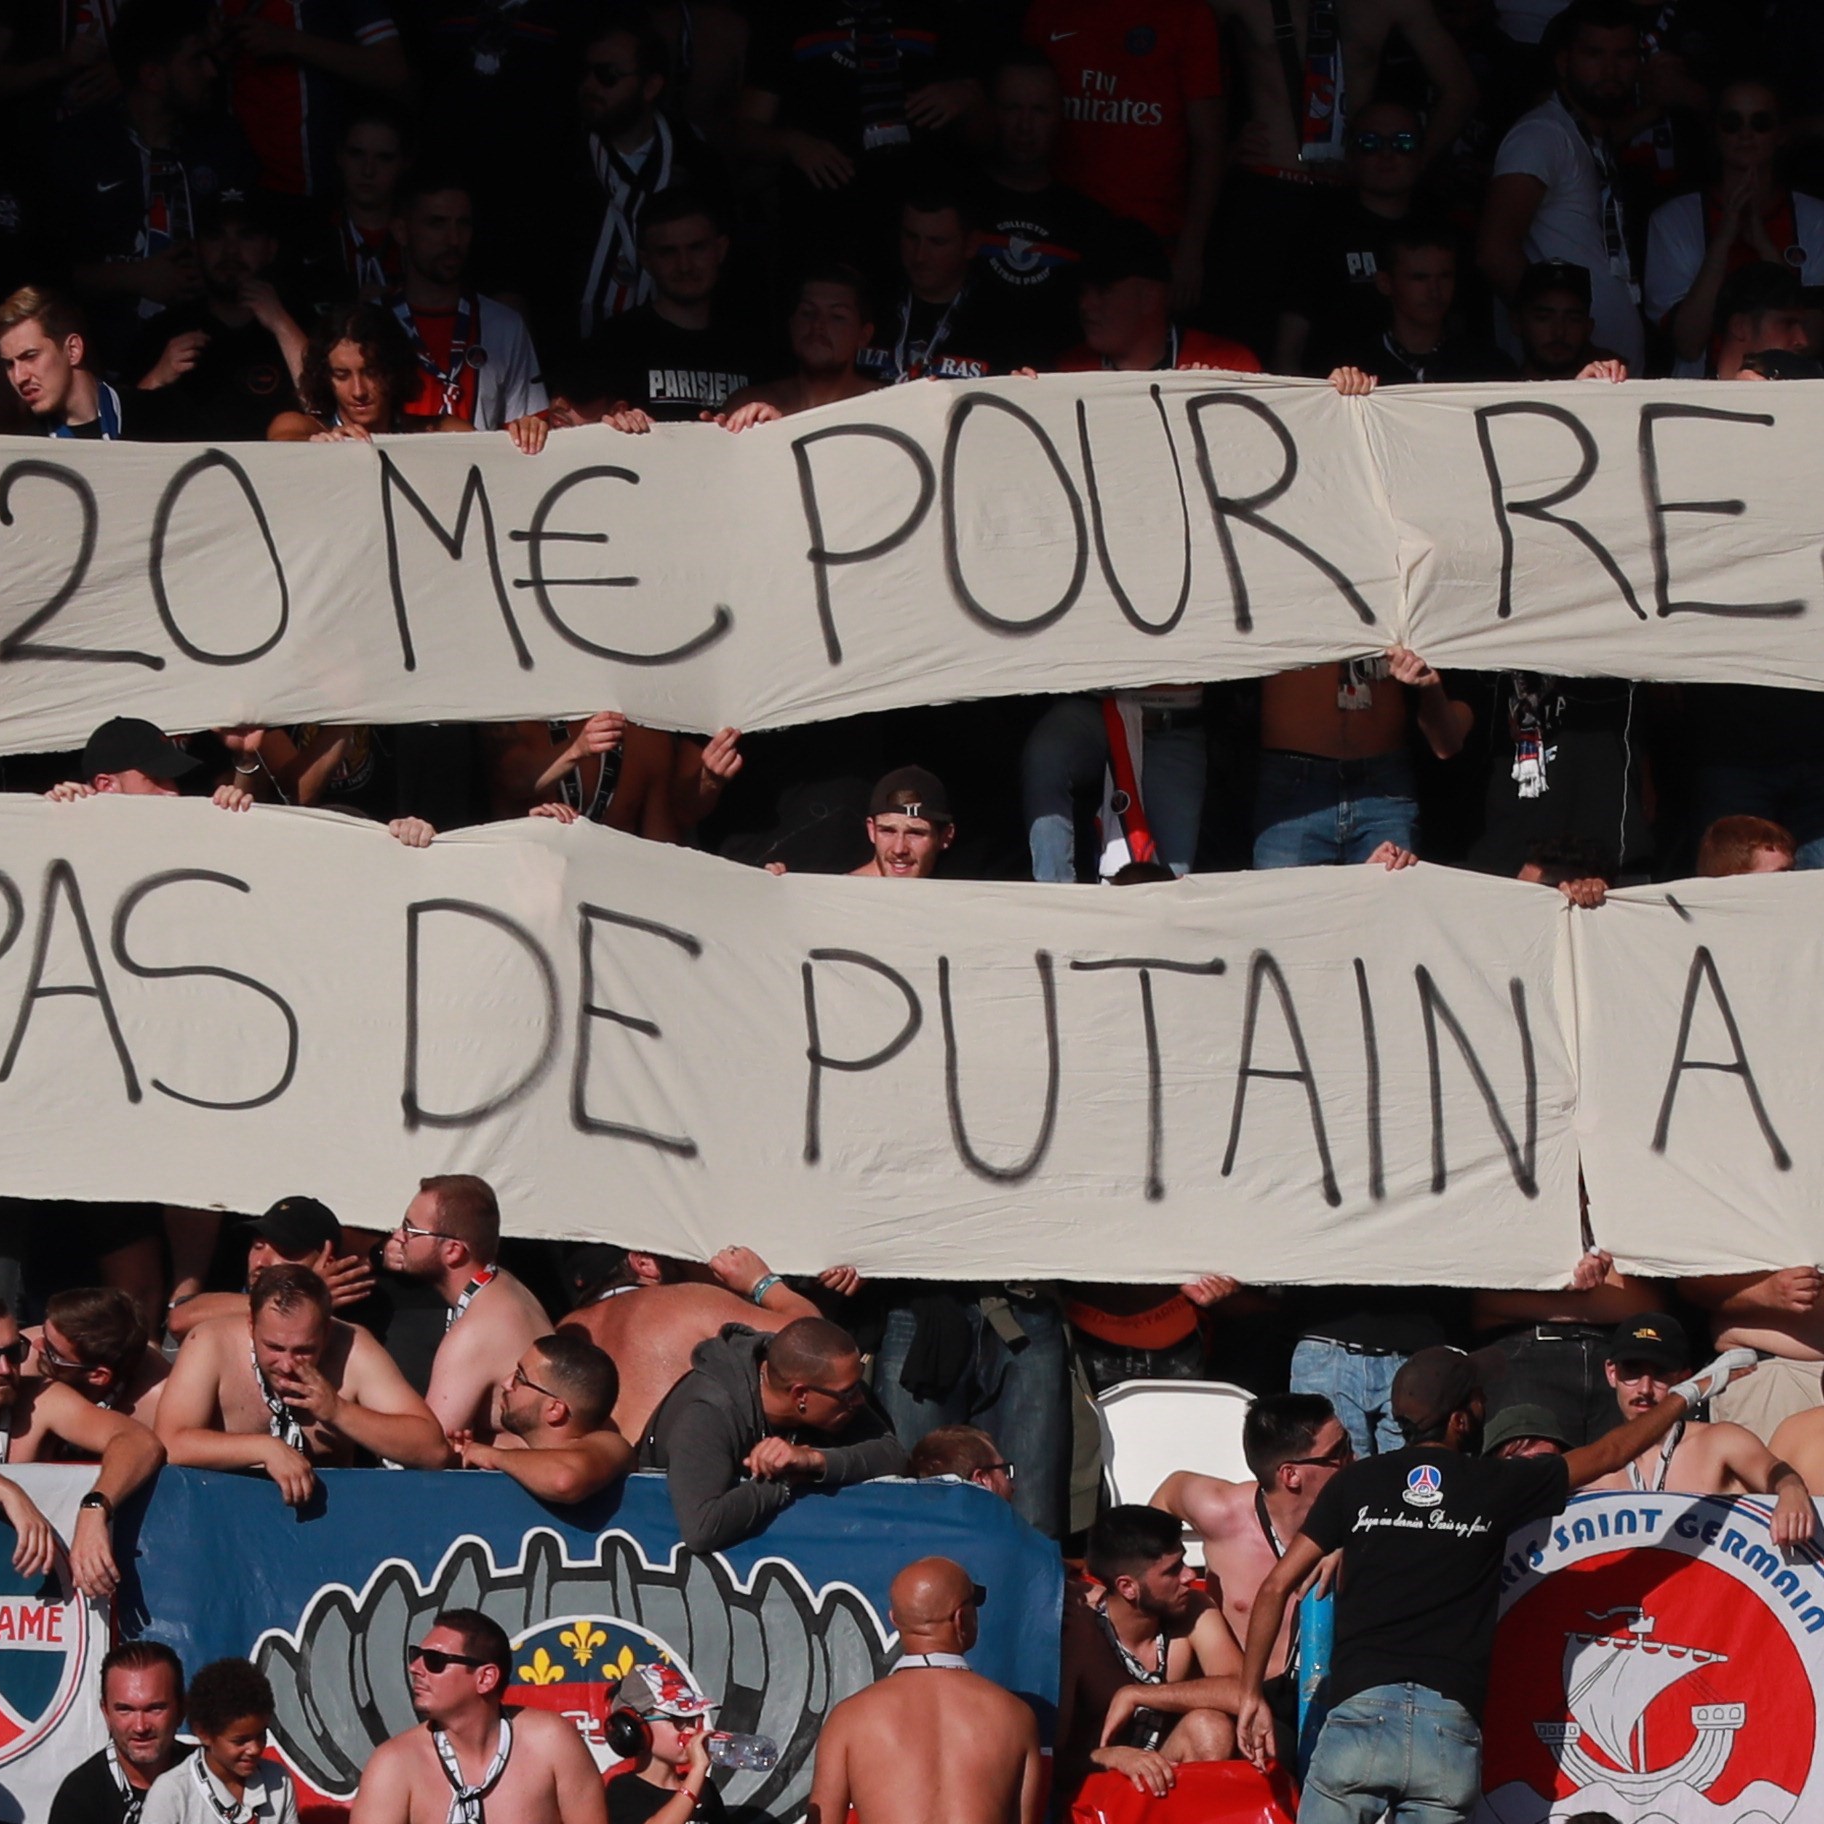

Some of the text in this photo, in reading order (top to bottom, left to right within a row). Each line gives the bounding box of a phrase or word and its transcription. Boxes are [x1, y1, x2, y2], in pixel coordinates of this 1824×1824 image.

[1081, 68, 1117, 96] Fly
[939, 356, 982, 379] RAS
[791, 381, 1377, 667] POUR
[401, 895, 703, 1159] DE
[800, 946, 1542, 1207] PUTAIN
[1648, 892, 1793, 1173] À
[1553, 1508, 1663, 1552] SAINT
